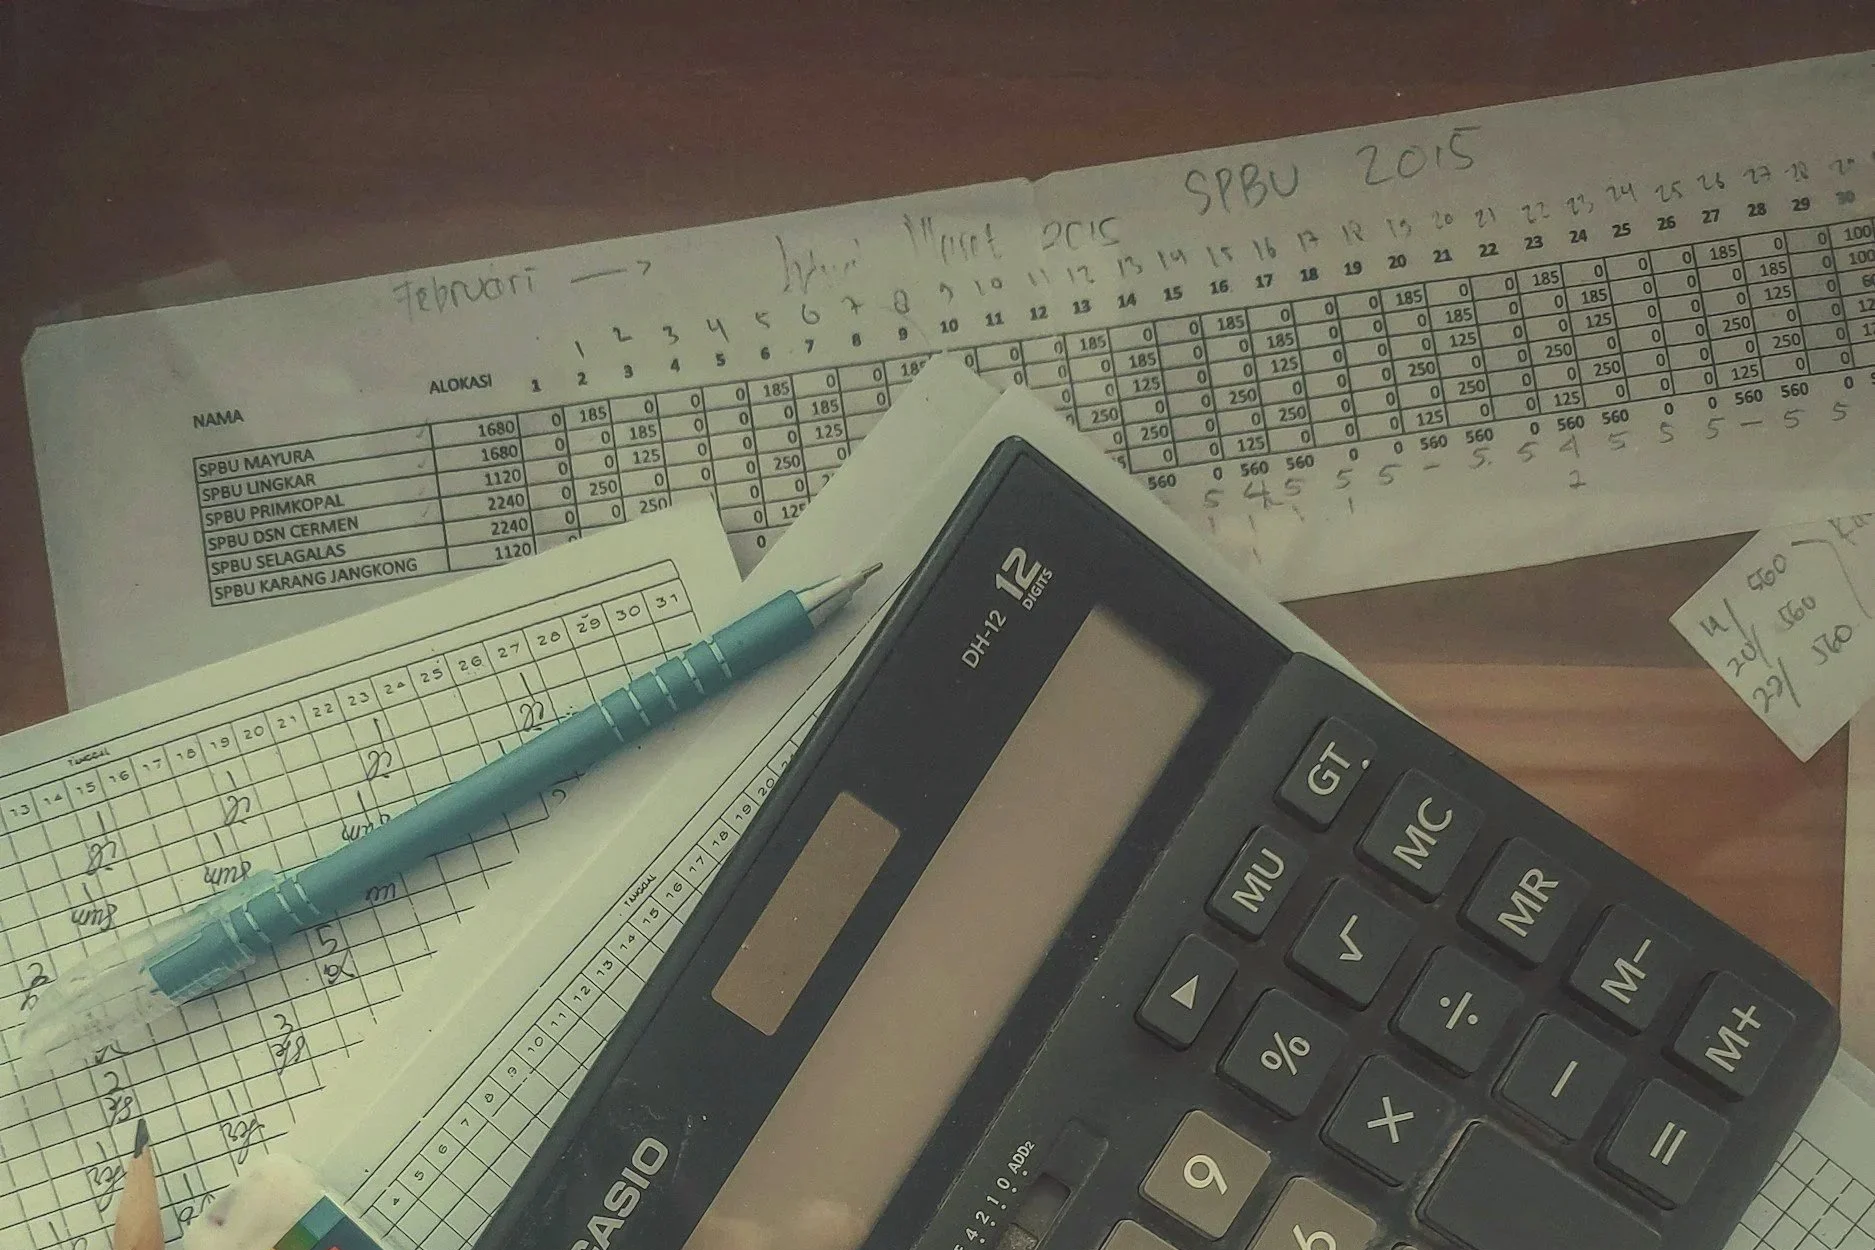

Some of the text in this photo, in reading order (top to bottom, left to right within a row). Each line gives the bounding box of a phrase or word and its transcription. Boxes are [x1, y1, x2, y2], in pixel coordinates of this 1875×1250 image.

[1185, 126, 1481, 216] SPBU 2015
[429, 197, 1811, 395] ALOKASI 1 2 6 7 10 11 13 15 17 19 20 23 24 26 27 29
[579, 244, 1738, 423] 185 185
[1132, 331, 1477, 393] 125 125
[193, 409, 244, 428] NAMA
[773, 314, 1751, 472] 250 250 250
[199, 420, 516, 477] SPBU MAYURA 1680
[1240, 381, 1809, 477] 560 560 560 560
[202, 444, 519, 502] SPBU LINGKAR 1680
[205, 468, 523, 526] SPBU PRIMKOPAL 1120
[208, 493, 526, 551] SPBU DSN CERMEN 2240
[211, 517, 530, 576] SPBU SELAGALAS 2240
[214, 541, 533, 601] SPBU KARANG JANGKONG 1120
[995, 547, 1041, 600] 12
[1022, 568, 1053, 611] DIGITS
[1747, 554, 1786, 590] 560
[961, 609, 1007, 669] DH-12
[1778, 596, 1816, 630] 560
[10, 593, 680, 817] 13 17 19 20 23 25 27 30 31
[1308, 741, 1351, 796] GT
[1393, 797, 1453, 869] MC
[1232, 848, 1285, 913] MU
[1497, 866, 1558, 938] MR
[415, 778, 775, 1180] 5 7 10 14 15 17 19 20
[1601, 939, 1652, 1004] M-
[1260, 1031, 1311, 1074] %
[1705, 1005, 1759, 1073] M+
[1182, 1154, 1228, 1195] 9
[965, 1228, 980, 1241] 4
[975, 1210, 991, 1225] 2
[986, 1194, 1000, 1208] 1
[996, 1177, 1011, 1191] 0
